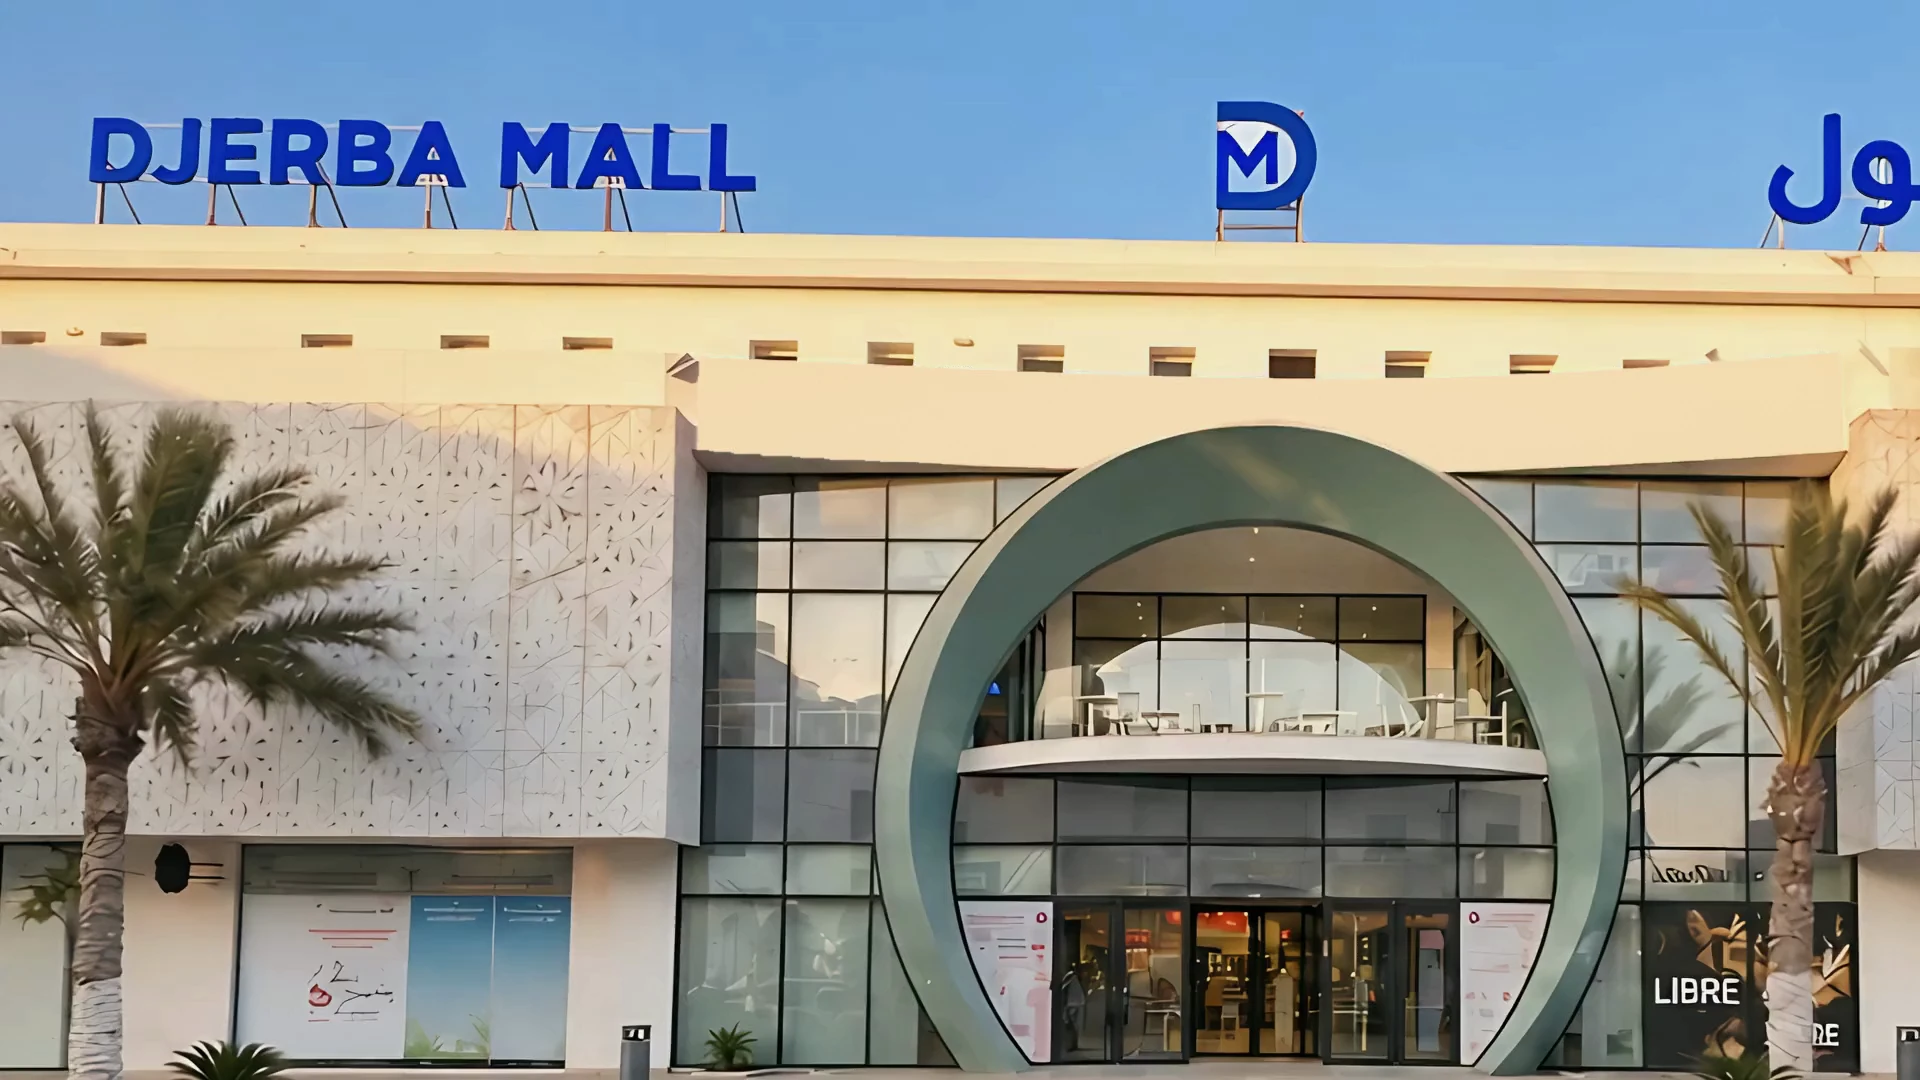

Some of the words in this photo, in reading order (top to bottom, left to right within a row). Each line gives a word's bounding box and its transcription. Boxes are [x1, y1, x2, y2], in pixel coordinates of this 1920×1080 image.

[89, 117, 467, 188] DJERBA
[499, 121, 757, 192] MALL
[1768, 113, 1920, 226] ول
[1654, 976, 1740, 1005] LIBRE
